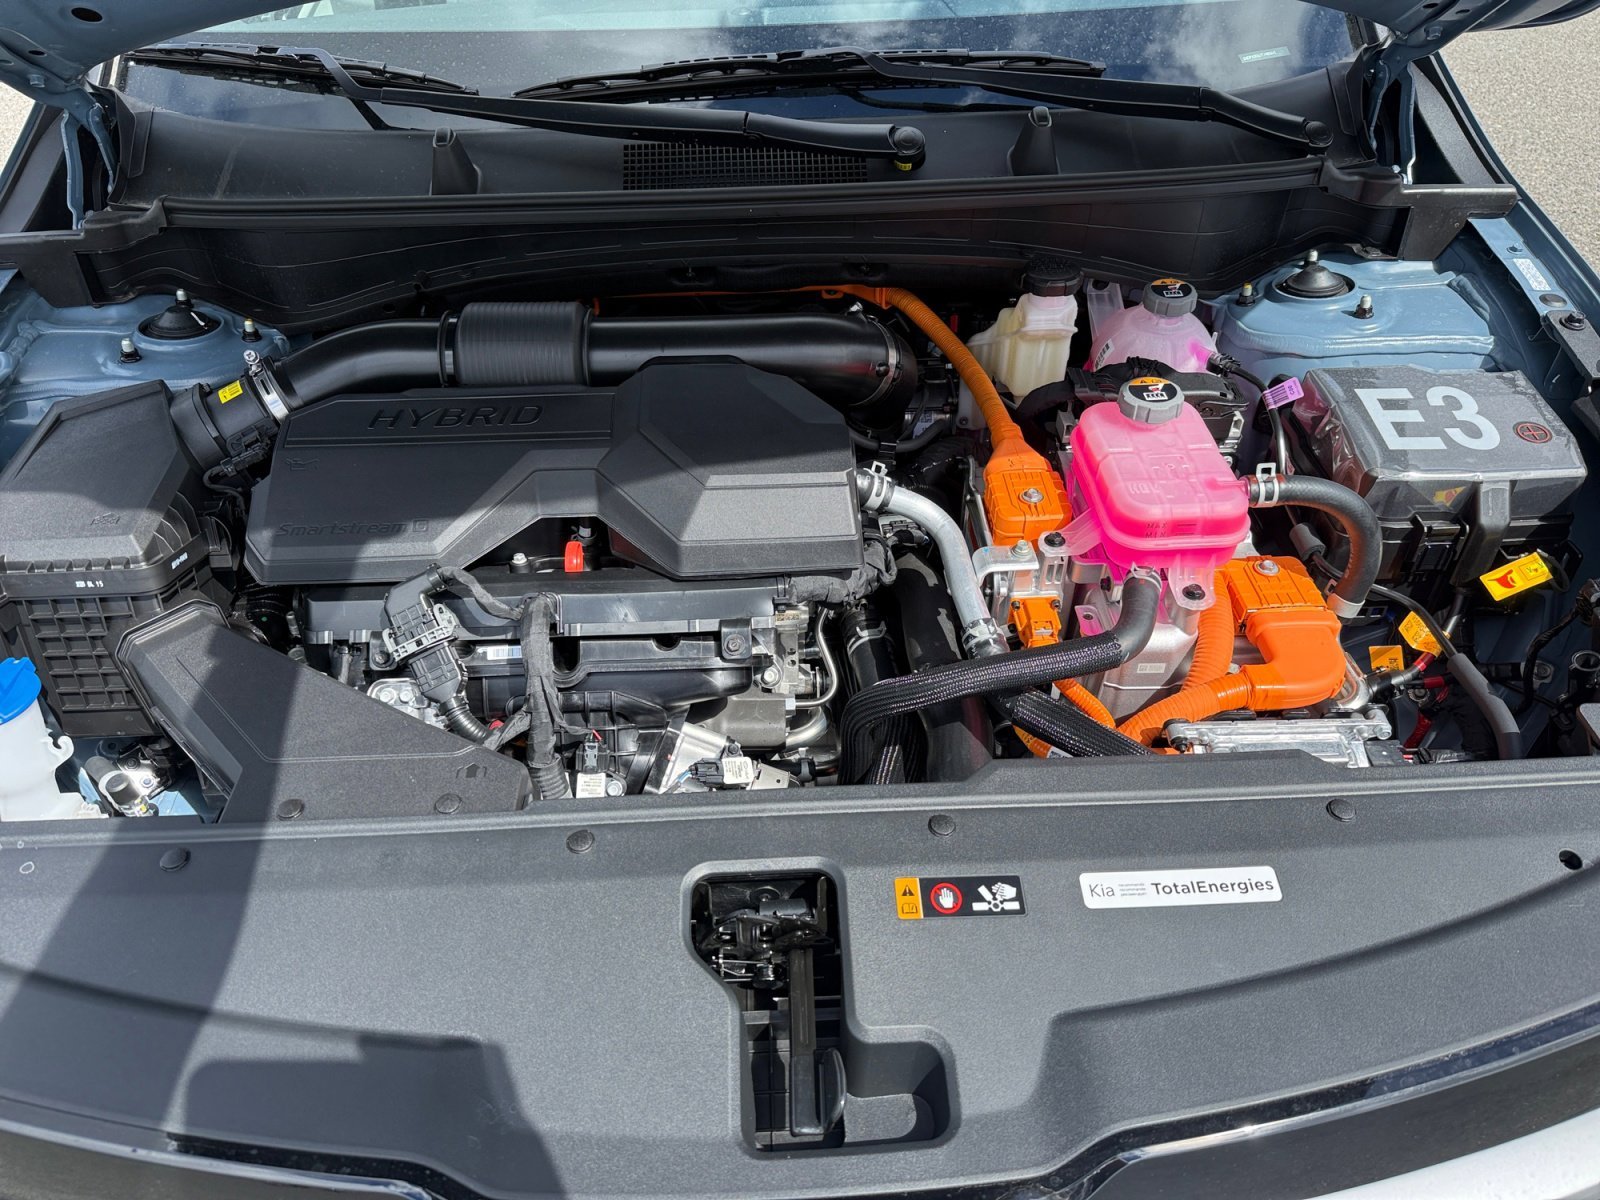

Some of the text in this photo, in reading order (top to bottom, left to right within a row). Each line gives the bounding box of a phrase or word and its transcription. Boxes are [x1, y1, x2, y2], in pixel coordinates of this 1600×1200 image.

[367, 405, 543, 429] HYBRID
[1353, 385, 1501, 451] E3
[275, 521, 408, 537] Smartstream
[1146, 521, 1168, 529] MAX
[1089, 878, 1274, 898] Kia TotalEnergies
